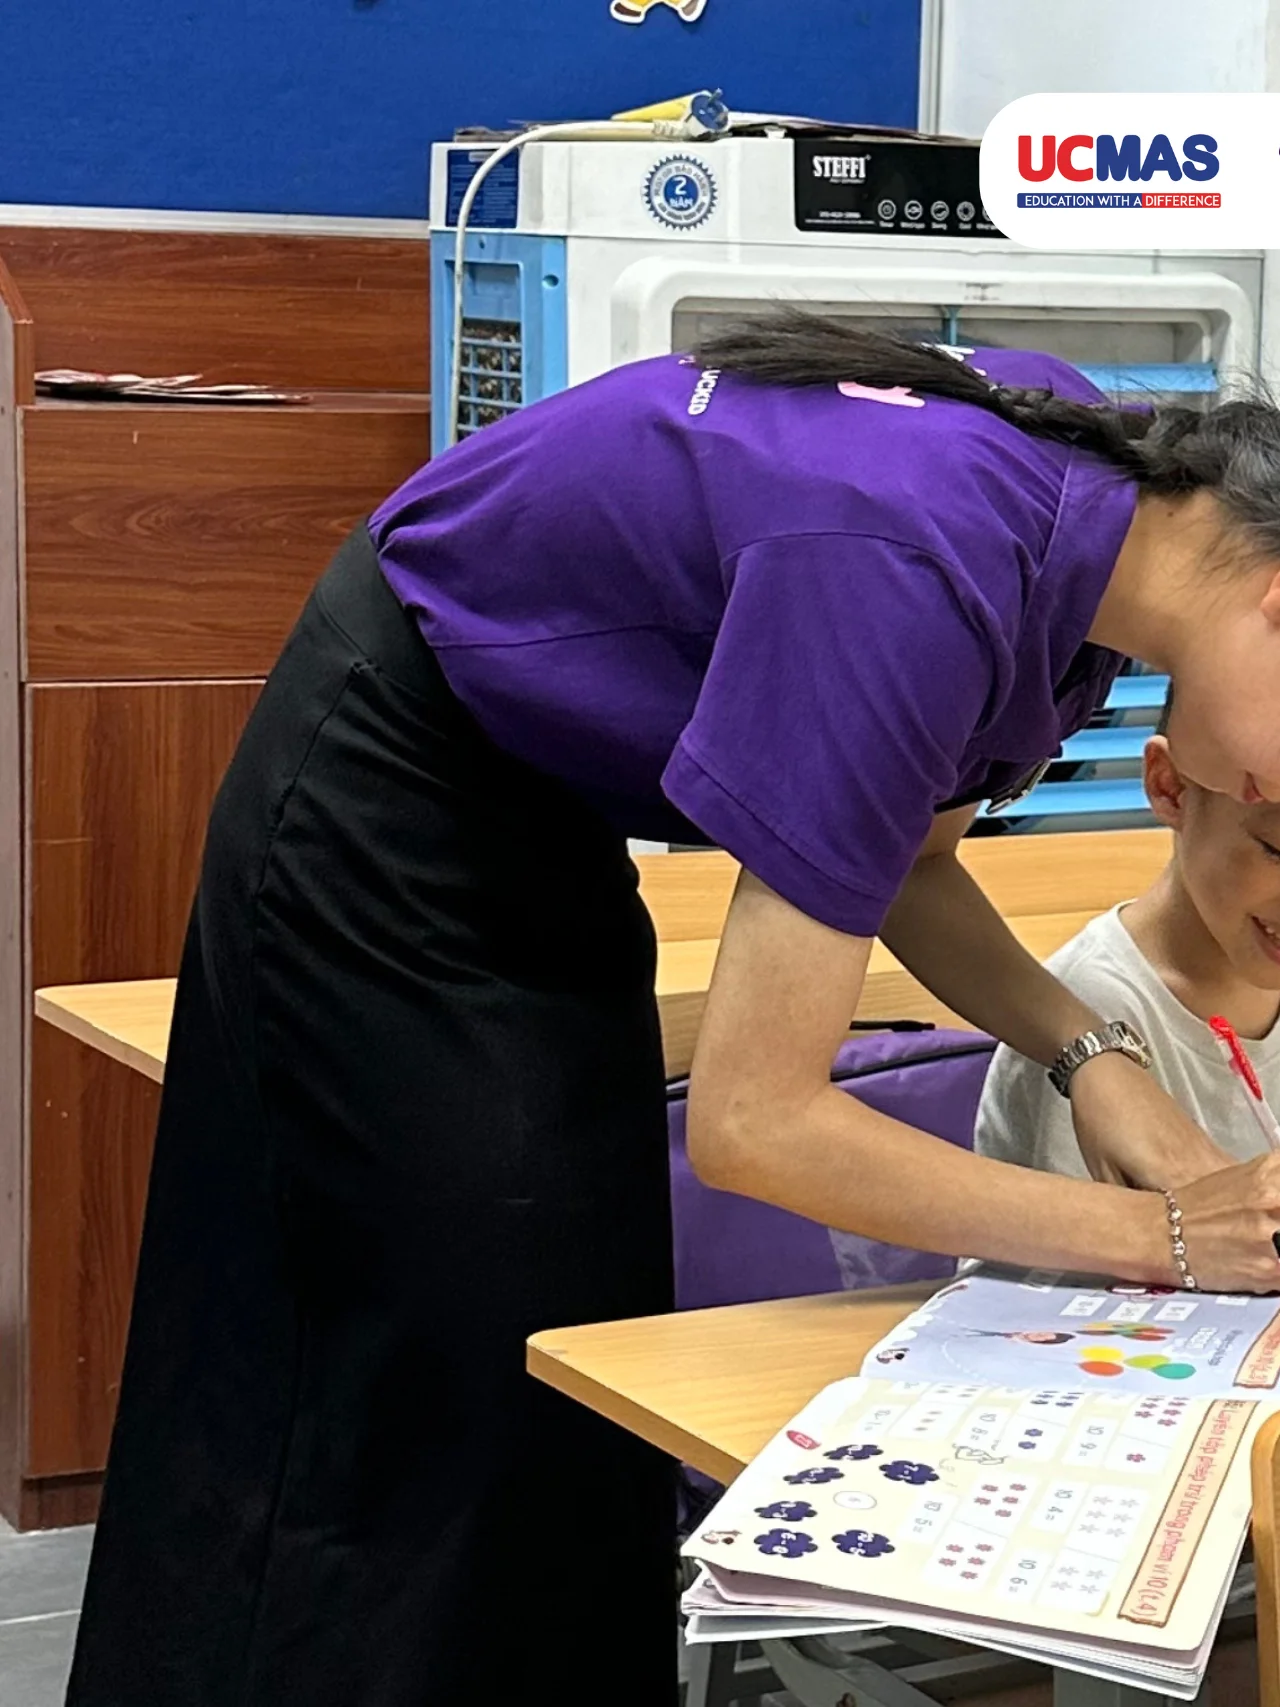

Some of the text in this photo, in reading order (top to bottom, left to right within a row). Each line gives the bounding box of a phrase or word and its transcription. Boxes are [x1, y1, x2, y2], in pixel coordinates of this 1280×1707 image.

[812, 155, 866, 178] STEFFI
[673, 176, 688, 196] 2
[687, 369, 722, 415] UCKID
[1147, 1575, 1170, 1589] 10
